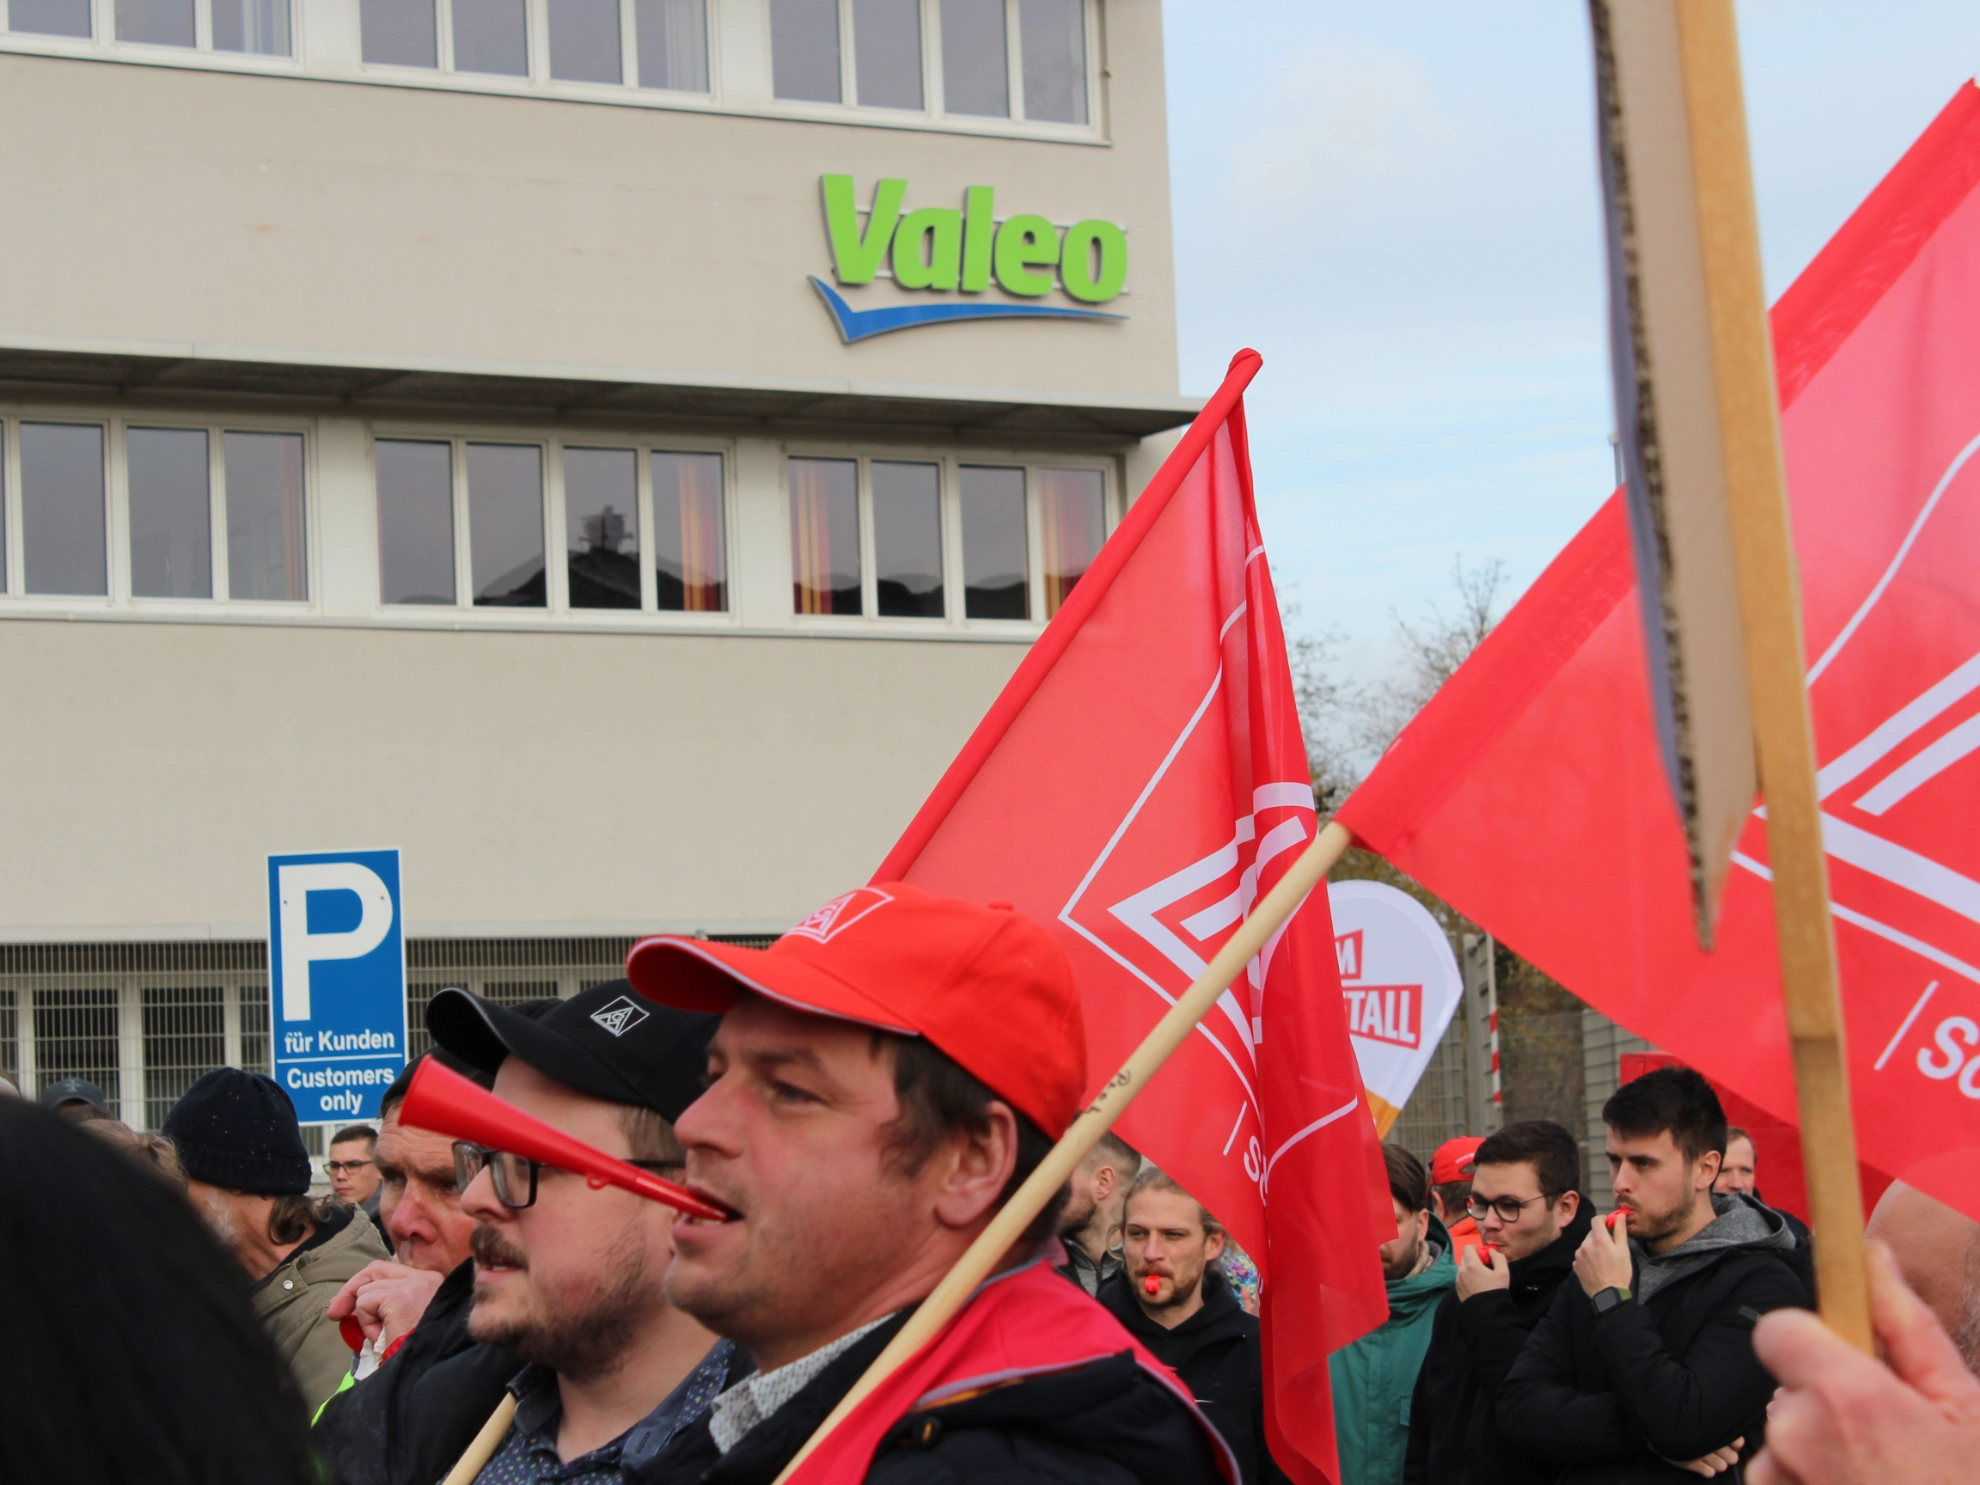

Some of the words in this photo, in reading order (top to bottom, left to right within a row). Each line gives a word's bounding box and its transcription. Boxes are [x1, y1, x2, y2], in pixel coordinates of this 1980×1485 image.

[819, 173, 1128, 303] Valeo
[278, 862, 393, 1022] P
[1342, 988, 1417, 1045] TALL
[284, 1031, 314, 1054] für
[318, 1028, 396, 1052] Kunden
[286, 1066, 396, 1090] Customers
[319, 1088, 364, 1116] only
